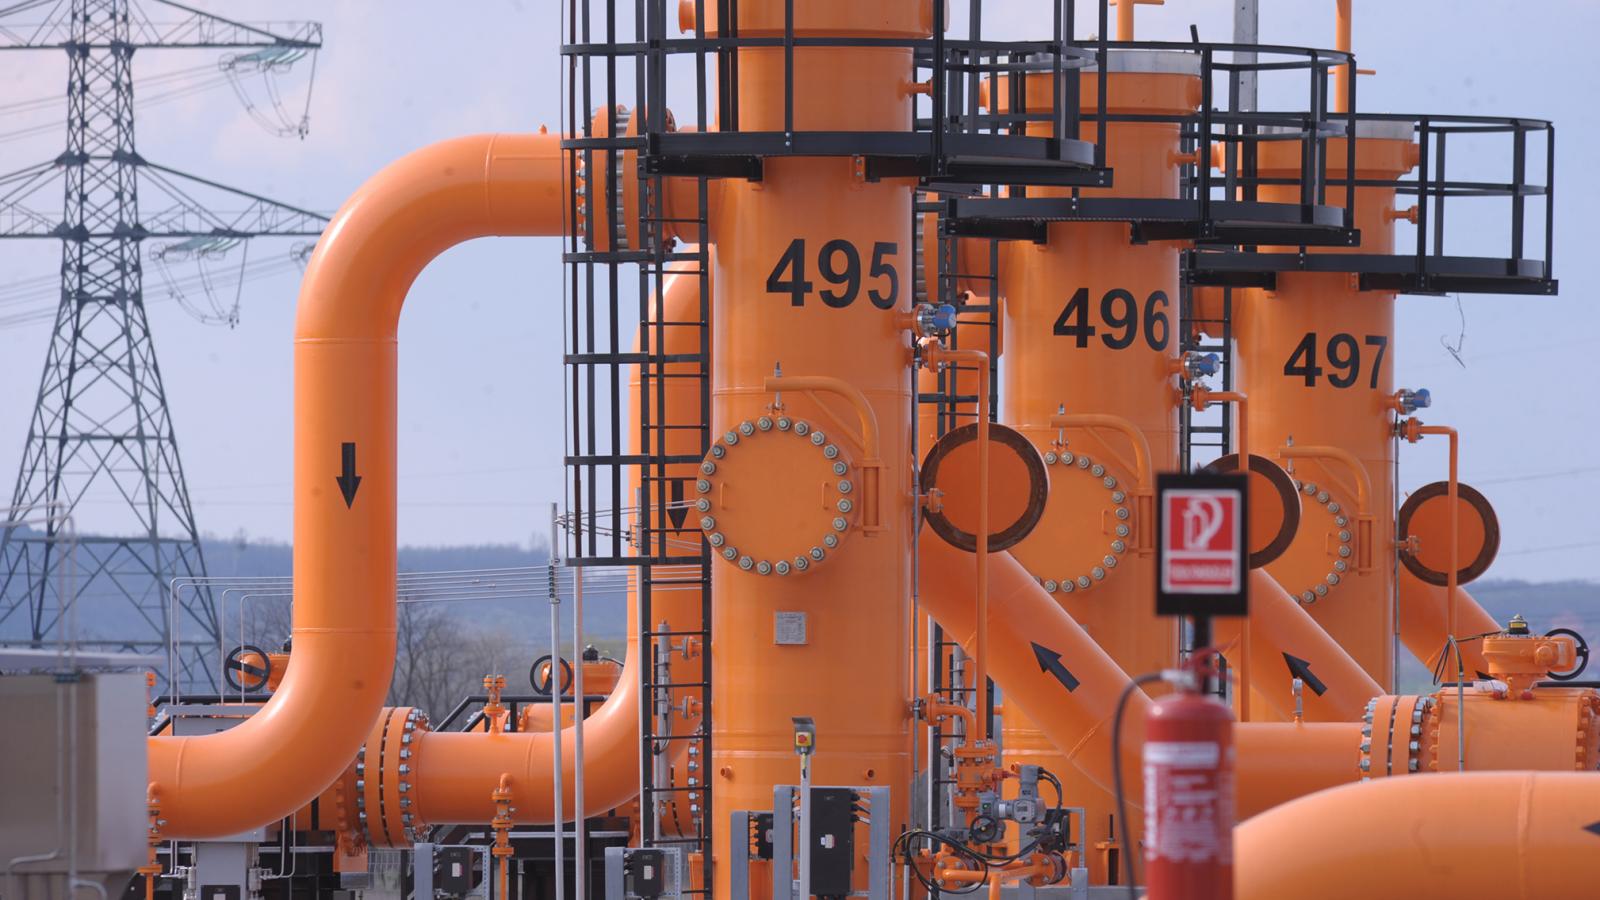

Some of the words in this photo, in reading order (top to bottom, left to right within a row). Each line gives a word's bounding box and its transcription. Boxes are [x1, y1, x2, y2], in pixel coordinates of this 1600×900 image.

[766, 238, 899, 310] 495
[1053, 287, 1170, 352] 496
[1283, 332, 1388, 389] 497
